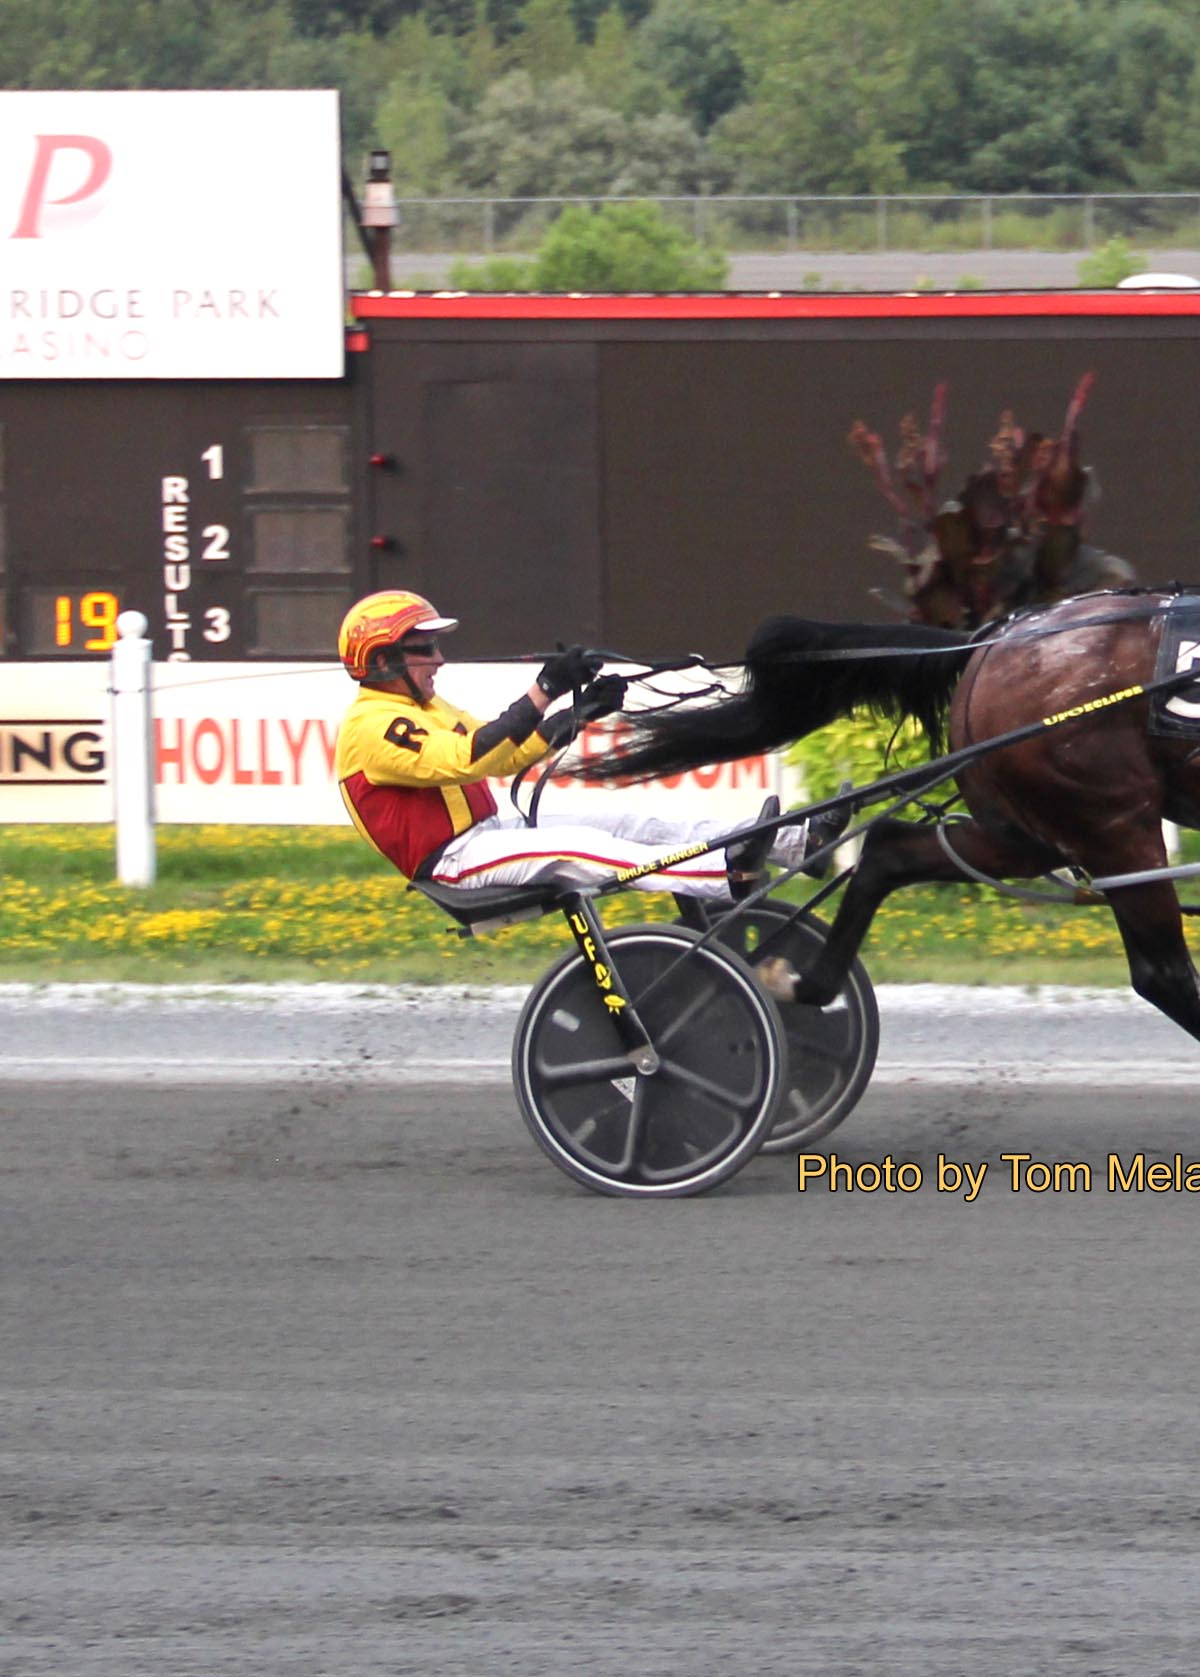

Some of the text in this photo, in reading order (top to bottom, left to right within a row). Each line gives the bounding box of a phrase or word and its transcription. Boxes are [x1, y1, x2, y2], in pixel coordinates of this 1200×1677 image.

[9, 134, 113, 239] P
[10, 289, 280, 319] RIDGE PARK
[202, 445, 224, 479] 1
[202, 525, 230, 560] 2
[55, 591, 118, 652] 19
[203, 606, 231, 642] 3
[0, 731, 106, 773] NG
[383, 716, 430, 754] R
